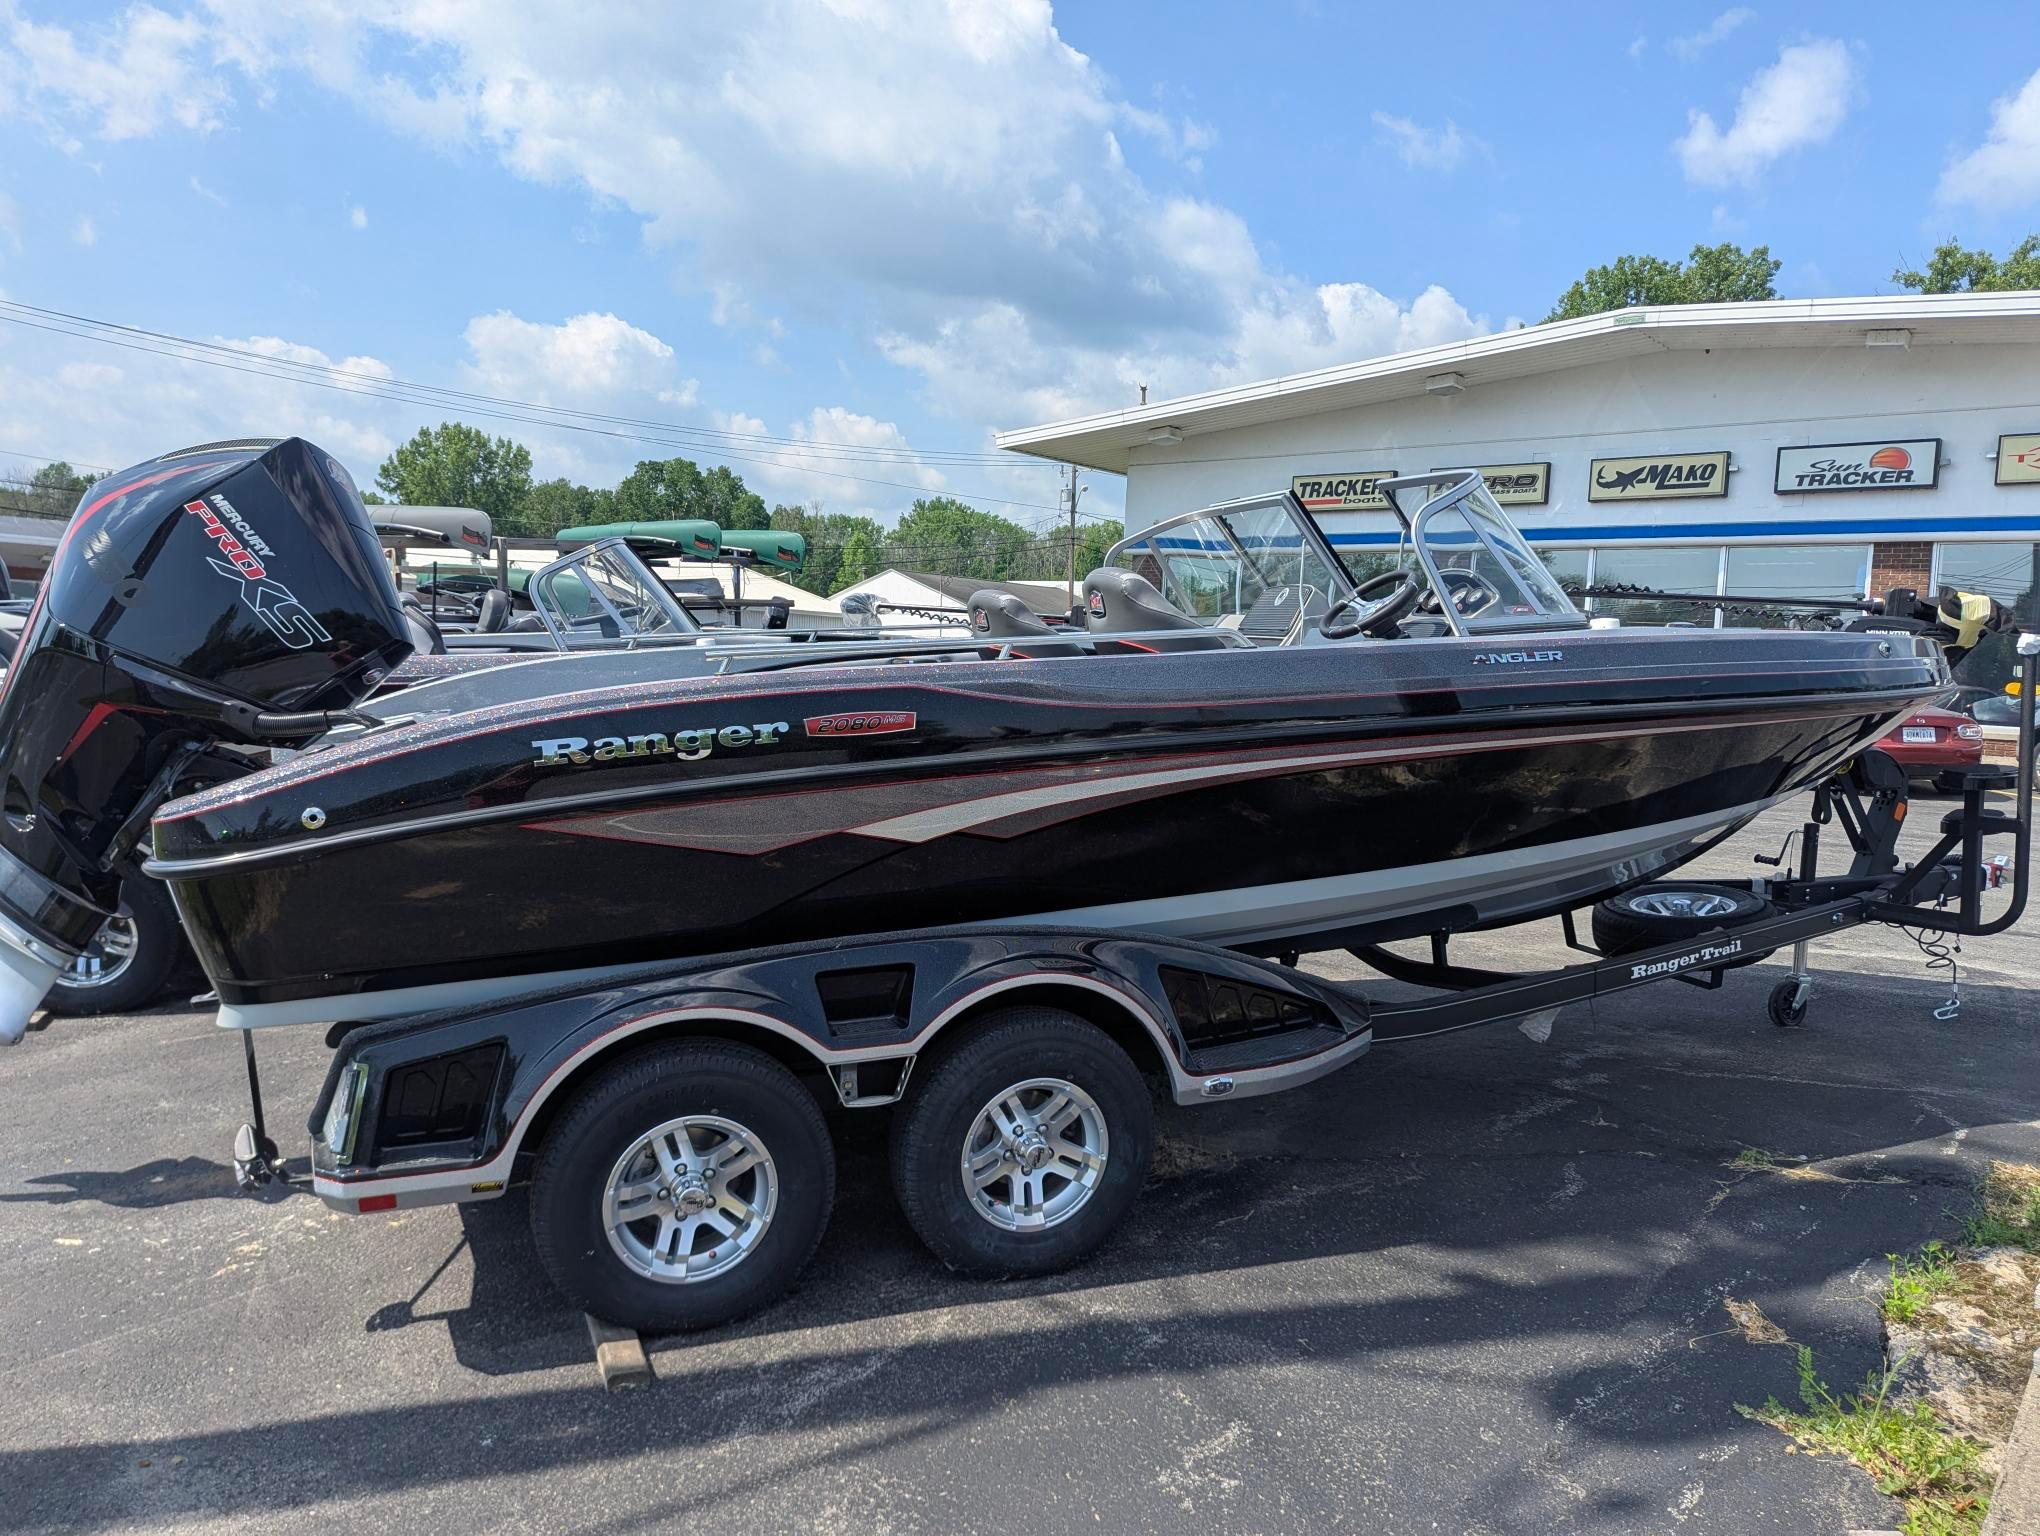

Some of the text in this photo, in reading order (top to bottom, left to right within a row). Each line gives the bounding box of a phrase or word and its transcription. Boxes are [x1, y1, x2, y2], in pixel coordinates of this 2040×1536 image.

[1635, 463, 1717, 490] MAKO
[1795, 470, 1914, 487] TRACKER
[1803, 459, 1864, 473] Sun
[1343, 496, 1384, 504] boats
[210, 493, 276, 557] MERCURY
[184, 499, 333, 648] PRO XS
[1472, 651, 1563, 665] ANGLER
[531, 721, 789, 767] Ranger
[1630, 940, 1742, 979] Ranger Trail
